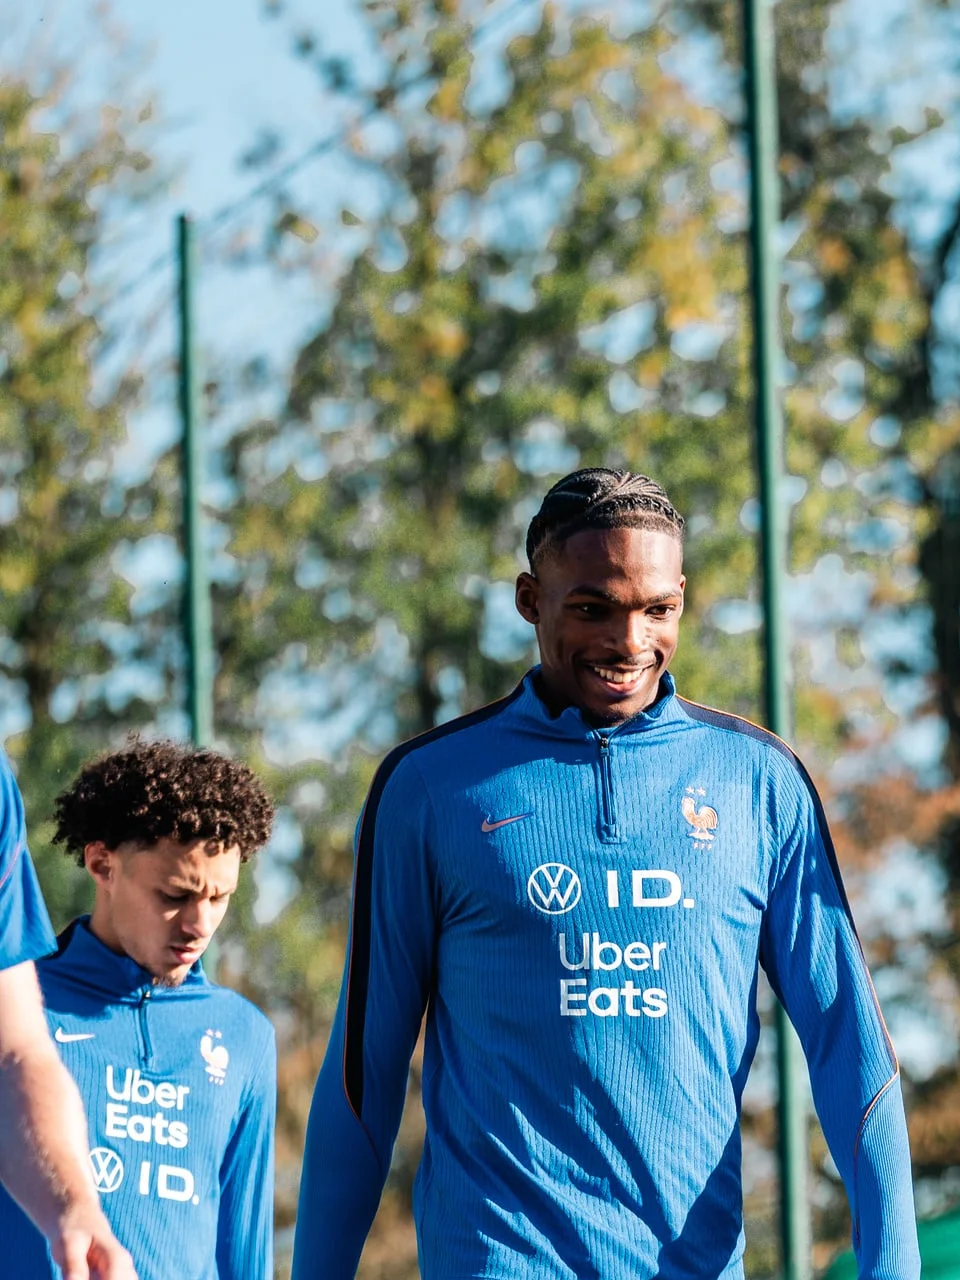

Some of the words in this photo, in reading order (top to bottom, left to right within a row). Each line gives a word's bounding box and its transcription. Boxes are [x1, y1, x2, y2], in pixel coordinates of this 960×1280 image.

[606, 869, 695, 909] ID.
[558, 931, 668, 971] Uber
[559, 977, 669, 1018] Eats
[105, 1065, 190, 1110] Uber
[105, 1103, 189, 1148] Eats
[138, 1160, 200, 1206] ID.
